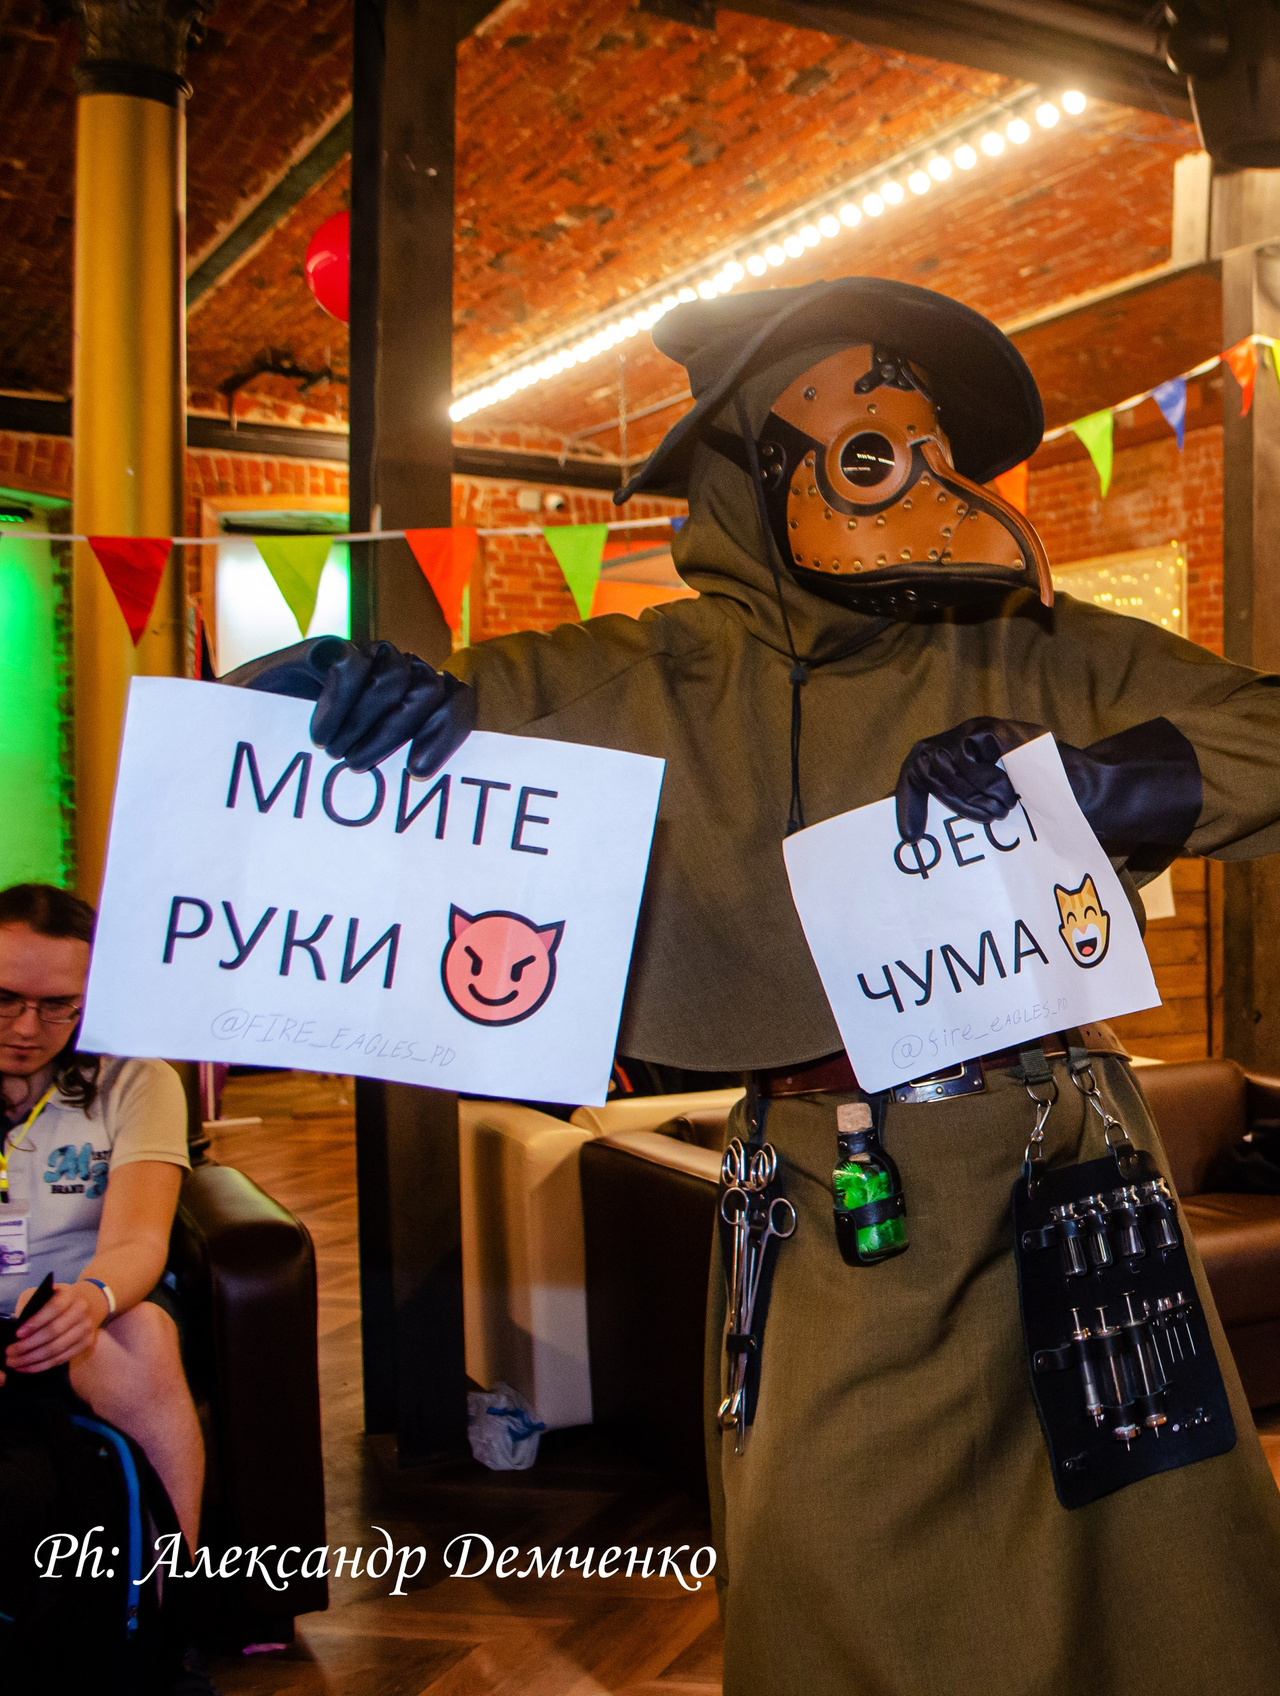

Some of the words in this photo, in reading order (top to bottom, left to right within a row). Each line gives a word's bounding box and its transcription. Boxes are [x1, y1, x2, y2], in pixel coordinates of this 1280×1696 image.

[225, 741, 559, 856] МОЙТЕ
[162, 895, 402, 990] РУКИ
[857, 919, 1050, 1014] ЧУМА
